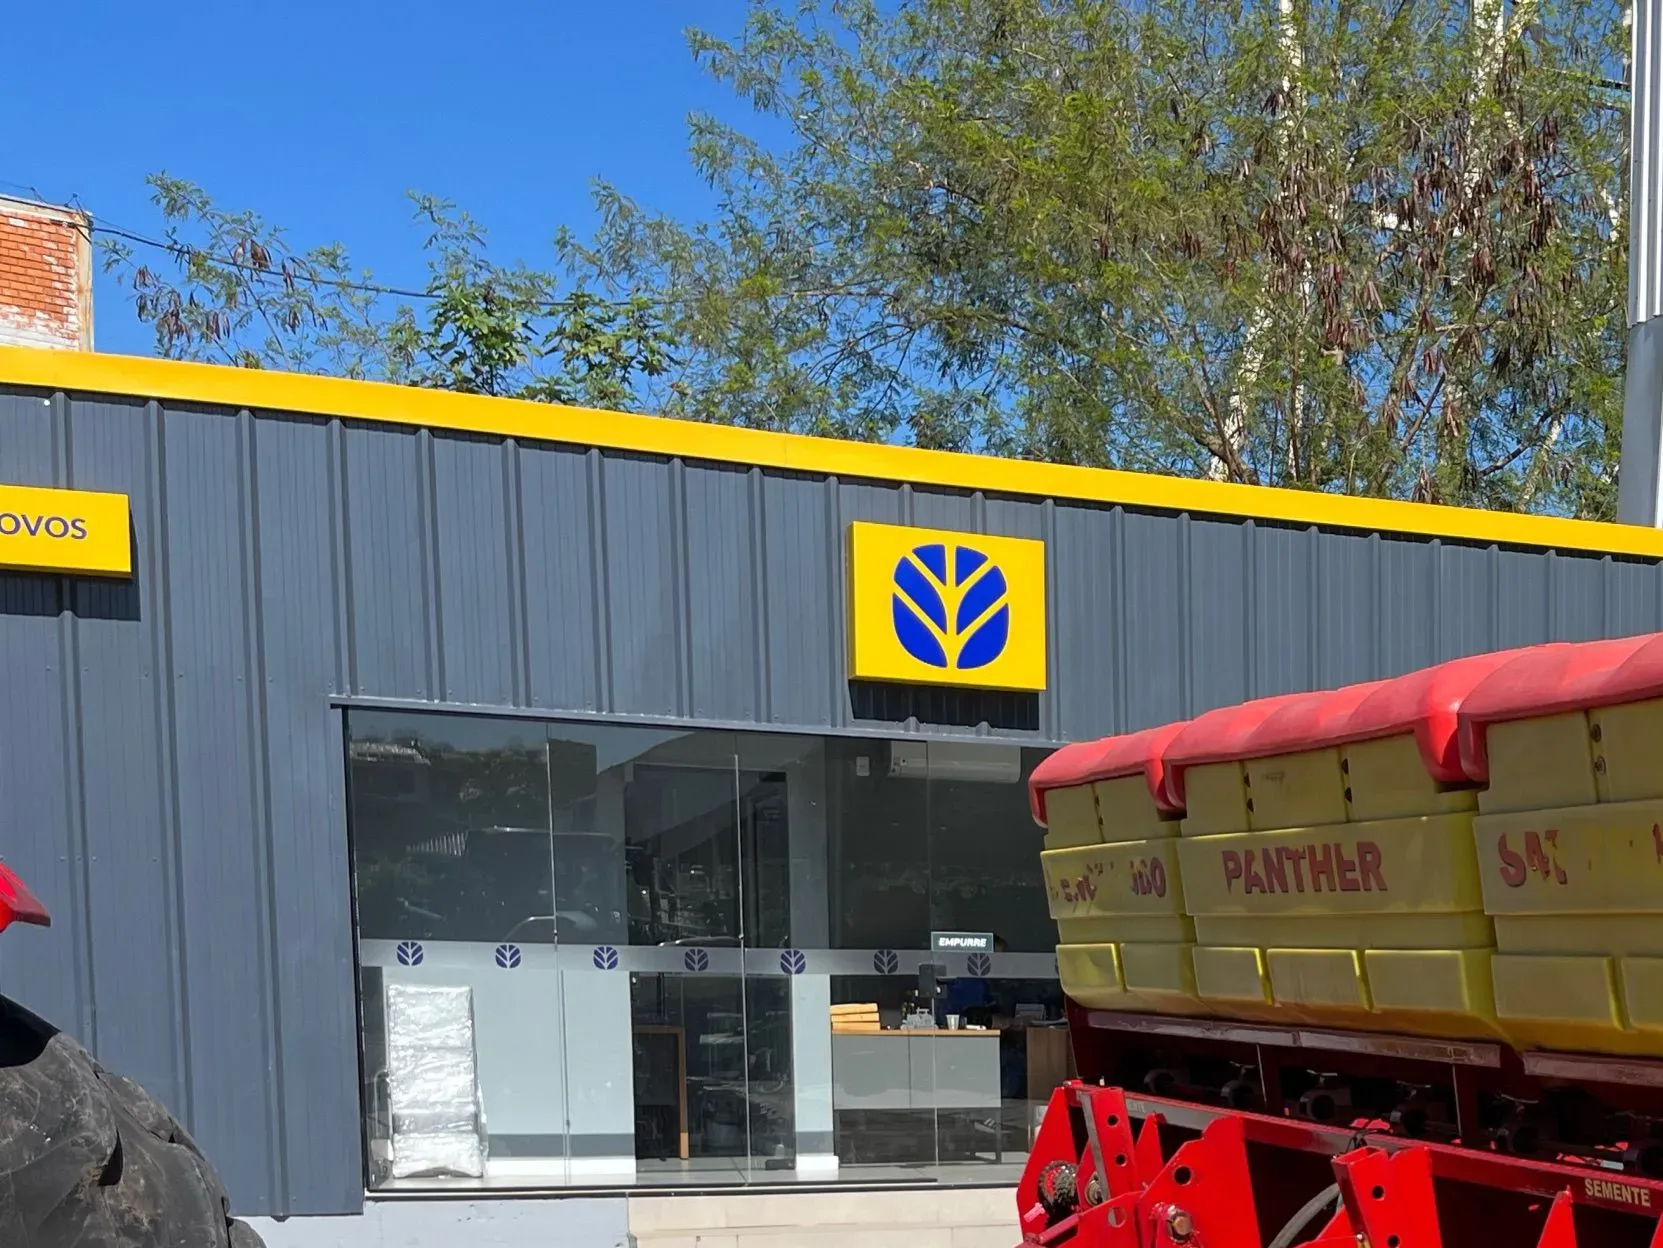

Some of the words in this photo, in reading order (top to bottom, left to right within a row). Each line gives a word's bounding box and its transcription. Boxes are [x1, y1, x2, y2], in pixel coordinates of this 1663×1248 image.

[0, 513, 87, 540] OVOS
[1222, 841, 1388, 894] PANTHER
[939, 936, 987, 948] EMPURRE
[1585, 1179, 1650, 1207] SEMENTE
